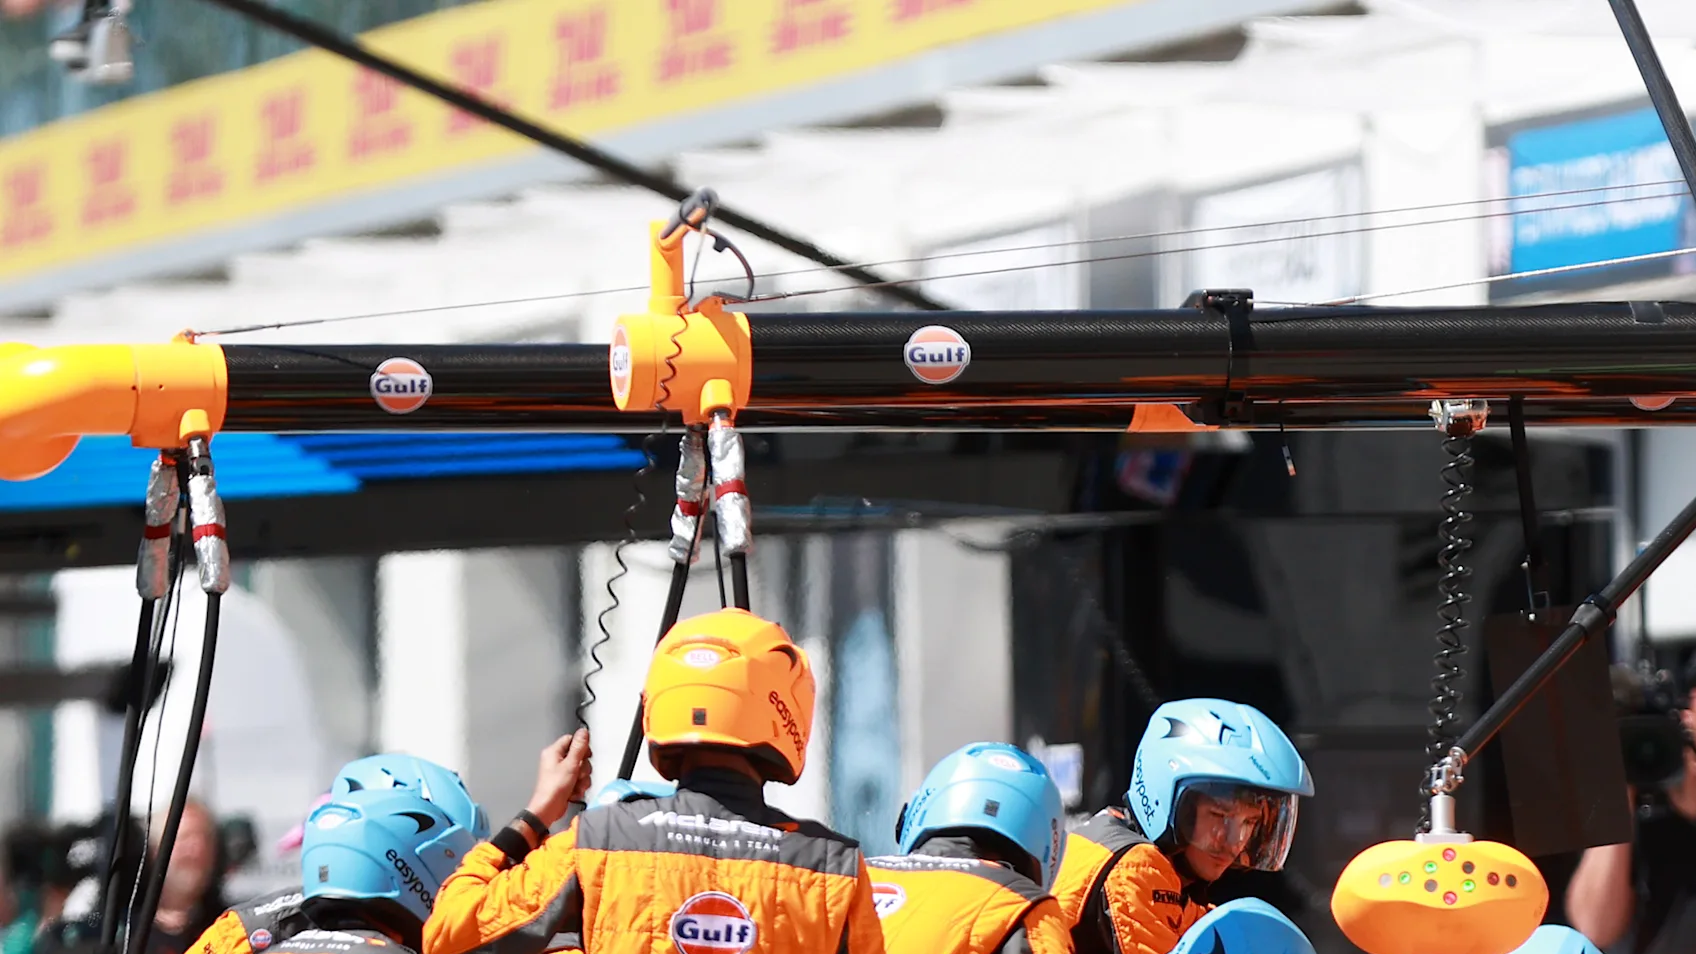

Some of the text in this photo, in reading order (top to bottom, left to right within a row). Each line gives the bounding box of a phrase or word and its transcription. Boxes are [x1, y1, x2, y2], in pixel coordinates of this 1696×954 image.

[612, 352, 629, 371] Gulf
[908, 346, 965, 363] Gulf
[375, 378, 428, 394] Gulf
[637, 810, 784, 838] McLaren
[667, 832, 727, 848] FORMULA
[747, 841, 780, 851] TEAM
[385, 848, 434, 914] easypos
[675, 918, 750, 943] Gulf
